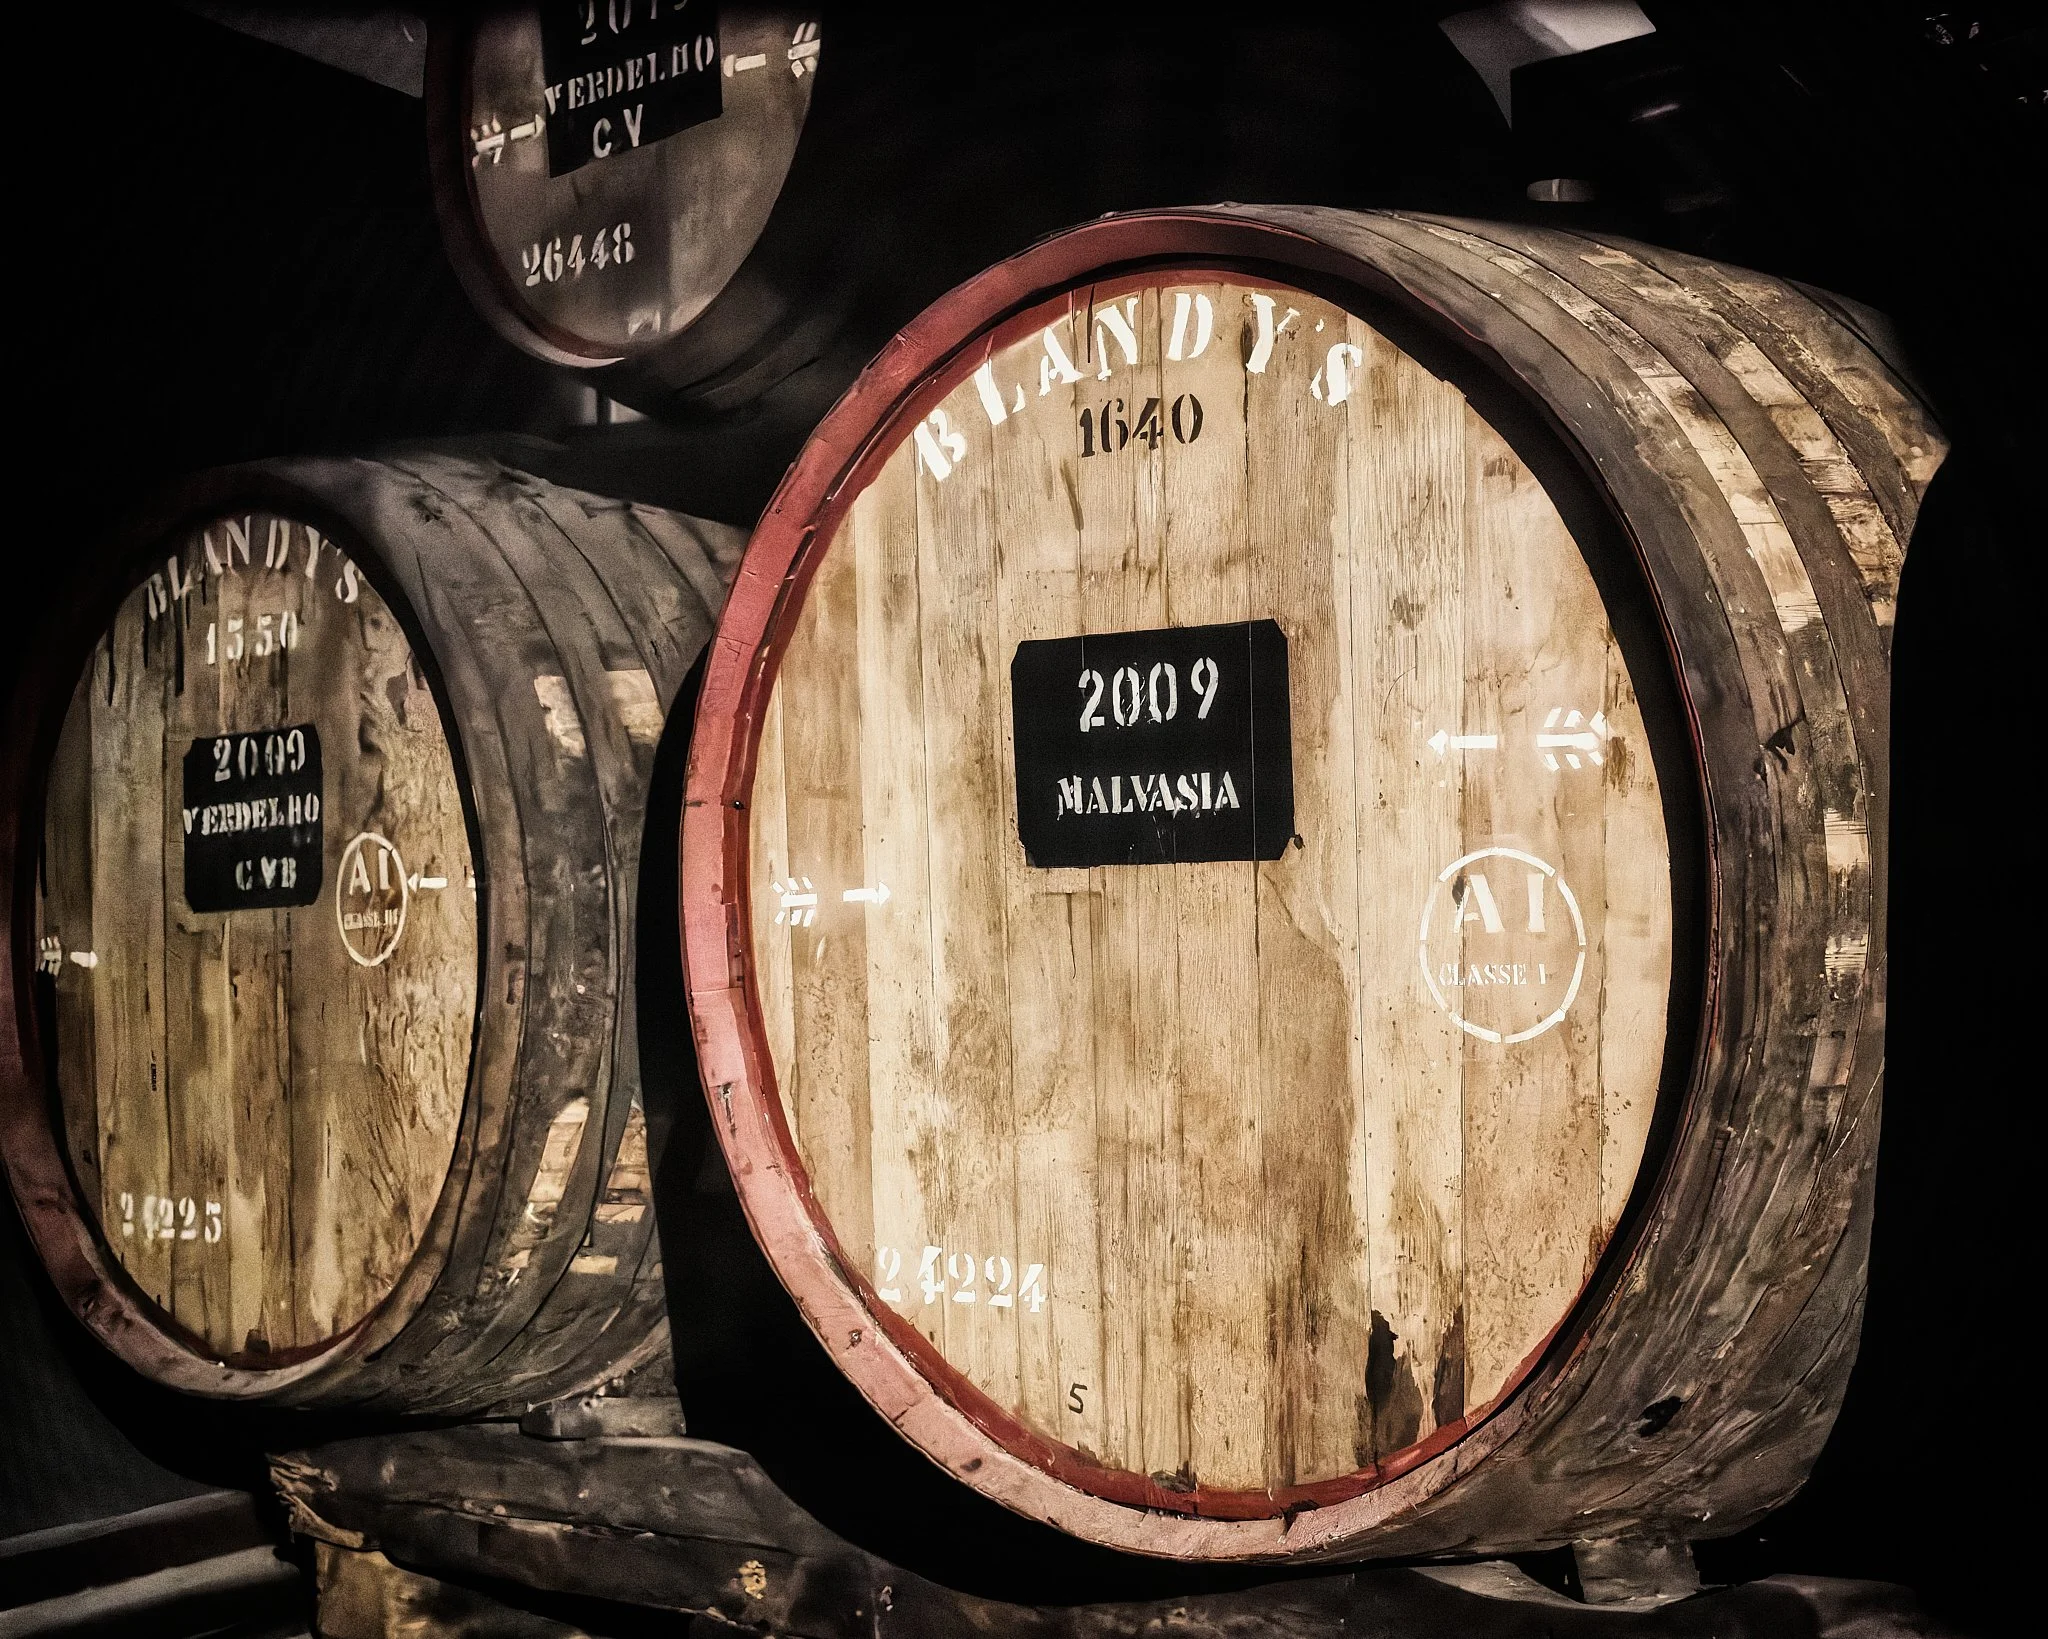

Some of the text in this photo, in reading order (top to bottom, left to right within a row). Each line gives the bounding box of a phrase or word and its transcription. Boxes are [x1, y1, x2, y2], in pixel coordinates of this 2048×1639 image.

[522, 223, 636, 287] 26448
[913, 292, 1363, 481] BLANDY'S
[1079, 394, 1204, 458] 1640
[206, 611, 298, 665] 1550
[1078, 657, 1219, 732] 2009
[213, 729, 306, 782] 2009
[183, 792, 320, 836] VERDELHO
[1056, 771, 1240, 818] MALVASIA
[1439, 963, 1527, 987] CLASSE
[878, 1246, 1046, 1313] 24224
[1068, 1383, 1088, 1414] 5
